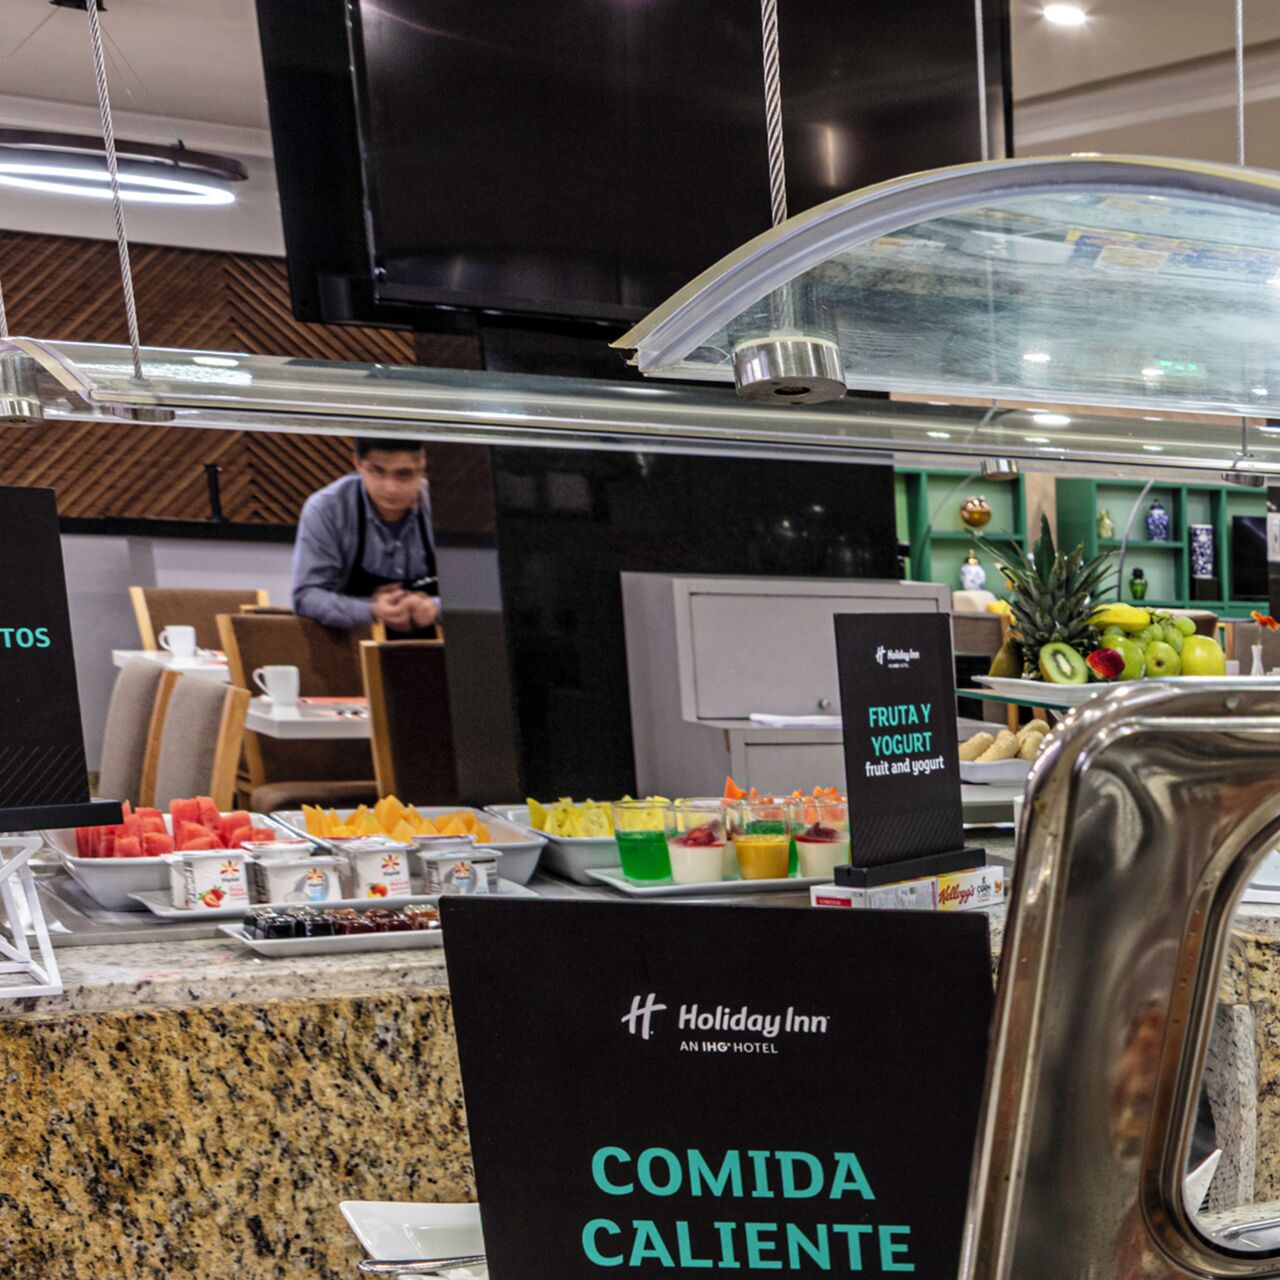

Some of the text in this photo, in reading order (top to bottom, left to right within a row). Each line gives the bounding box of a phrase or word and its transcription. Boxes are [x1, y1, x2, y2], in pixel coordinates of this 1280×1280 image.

[868, 703, 931, 728] FRUTA Y
[871, 732, 932, 756] YOGURT
[865, 755, 945, 777] fruit and yogurt
[938, 885, 975, 905] Kellogg's
[678, 1004, 781, 1038] Holiday
[785, 1006, 828, 1033] Inn
[680, 1041, 699, 1051] AN
[734, 1042, 779, 1054] HOTEL
[591, 1146, 876, 1200] COMIDA
[581, 1218, 916, 1272] CALIENTE
